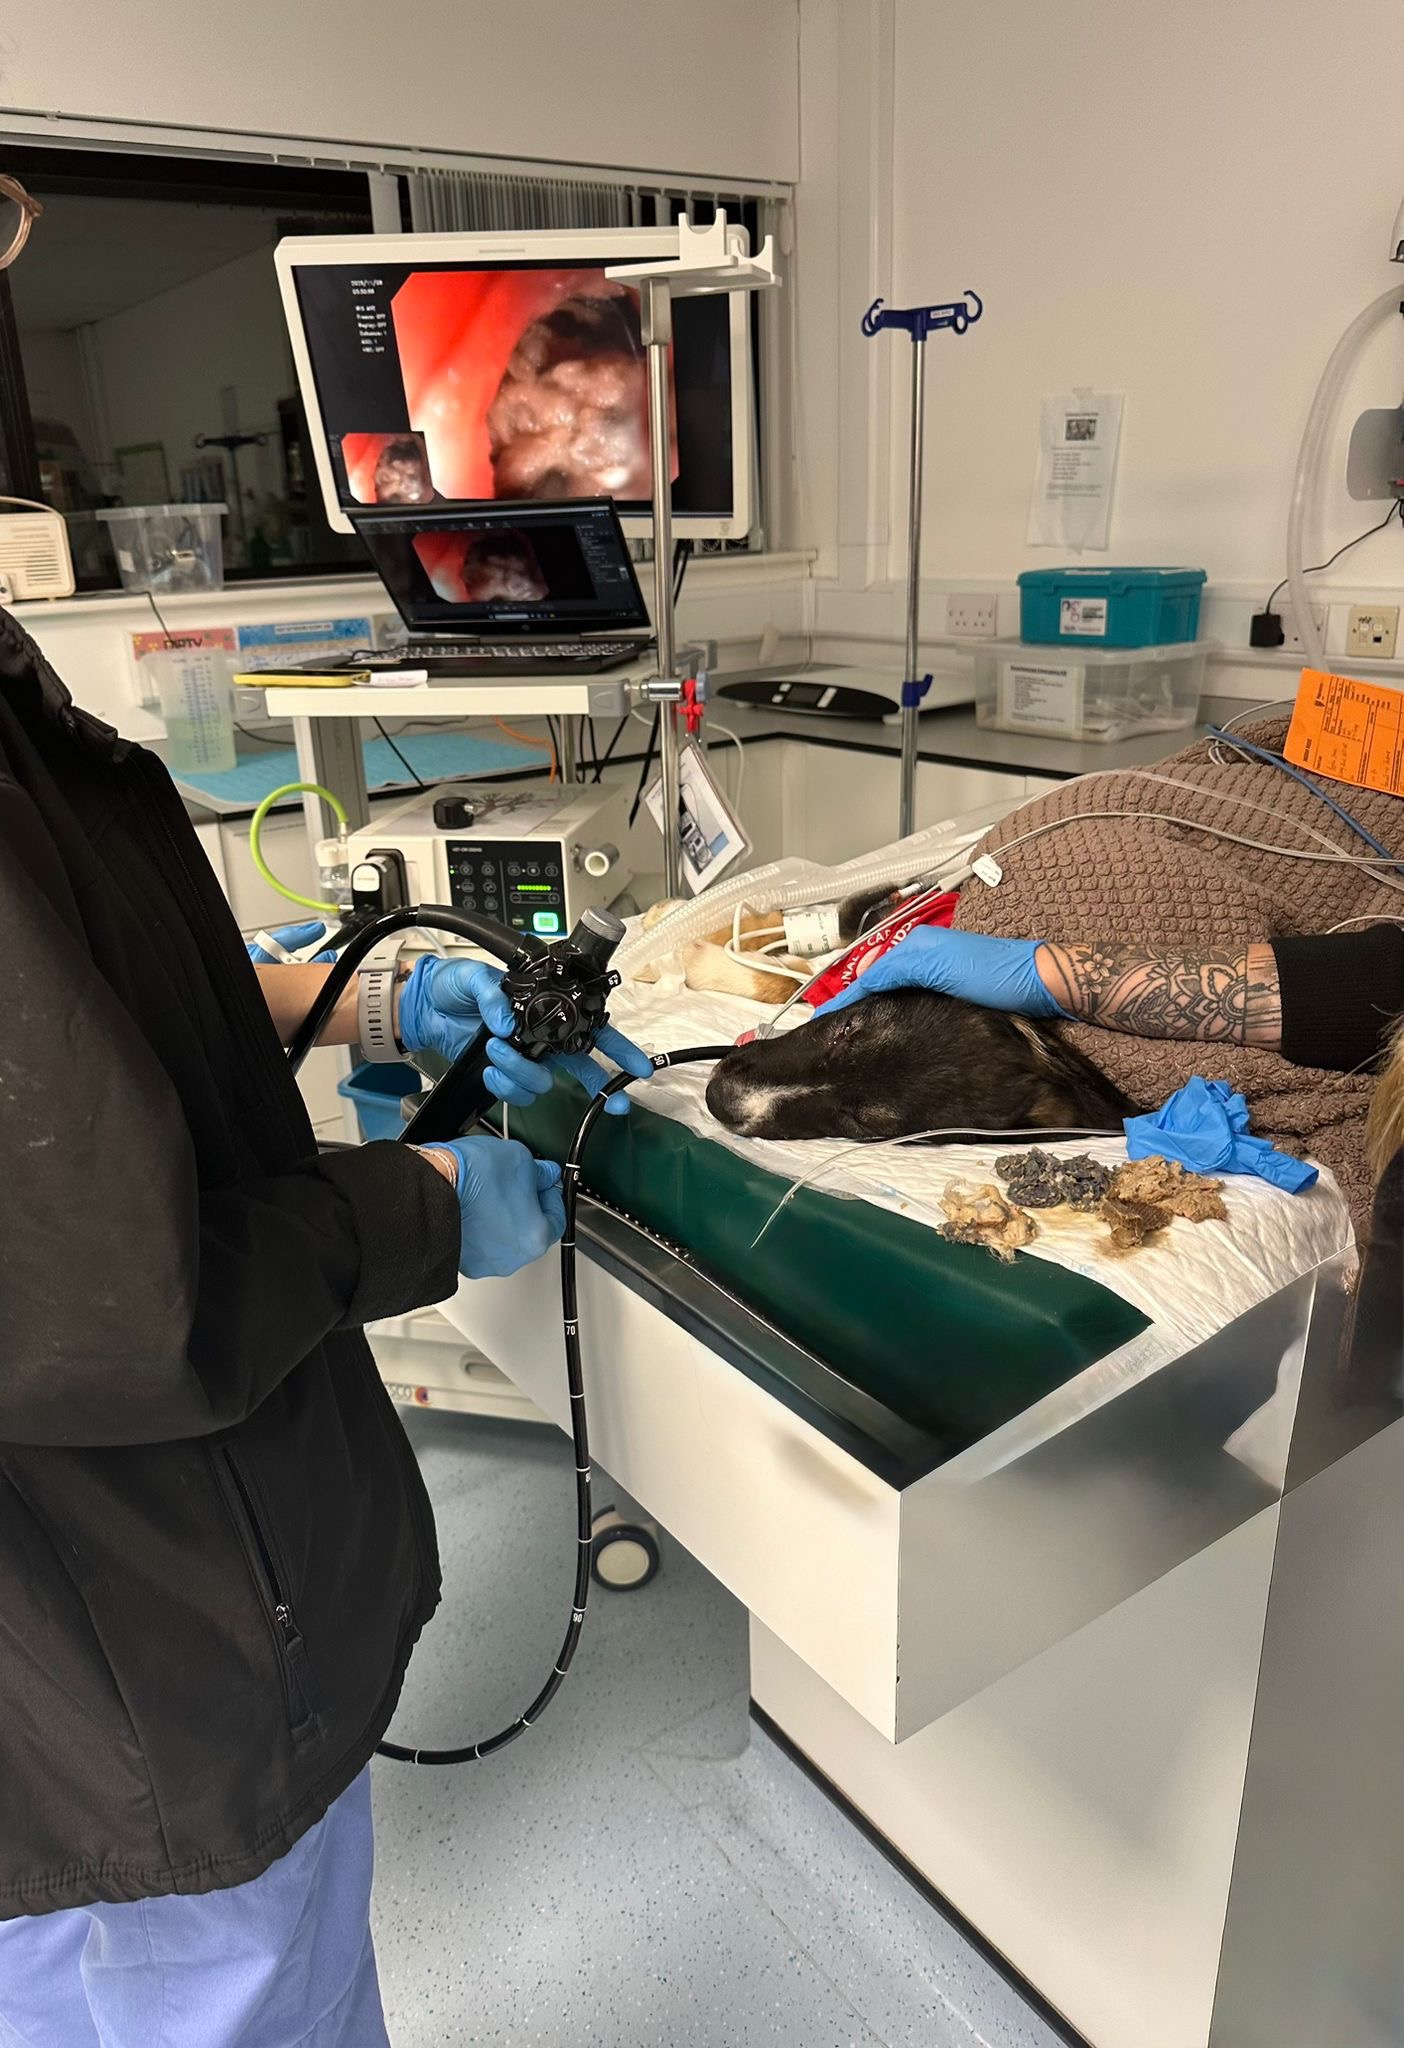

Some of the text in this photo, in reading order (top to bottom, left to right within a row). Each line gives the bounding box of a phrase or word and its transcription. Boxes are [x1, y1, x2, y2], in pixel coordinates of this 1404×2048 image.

[653, 1055, 665, 1066] 50
[565, 1325, 576, 1336] 70
[387, 1383, 412, 1400] SCO
[572, 1612, 583, 1623] 90
